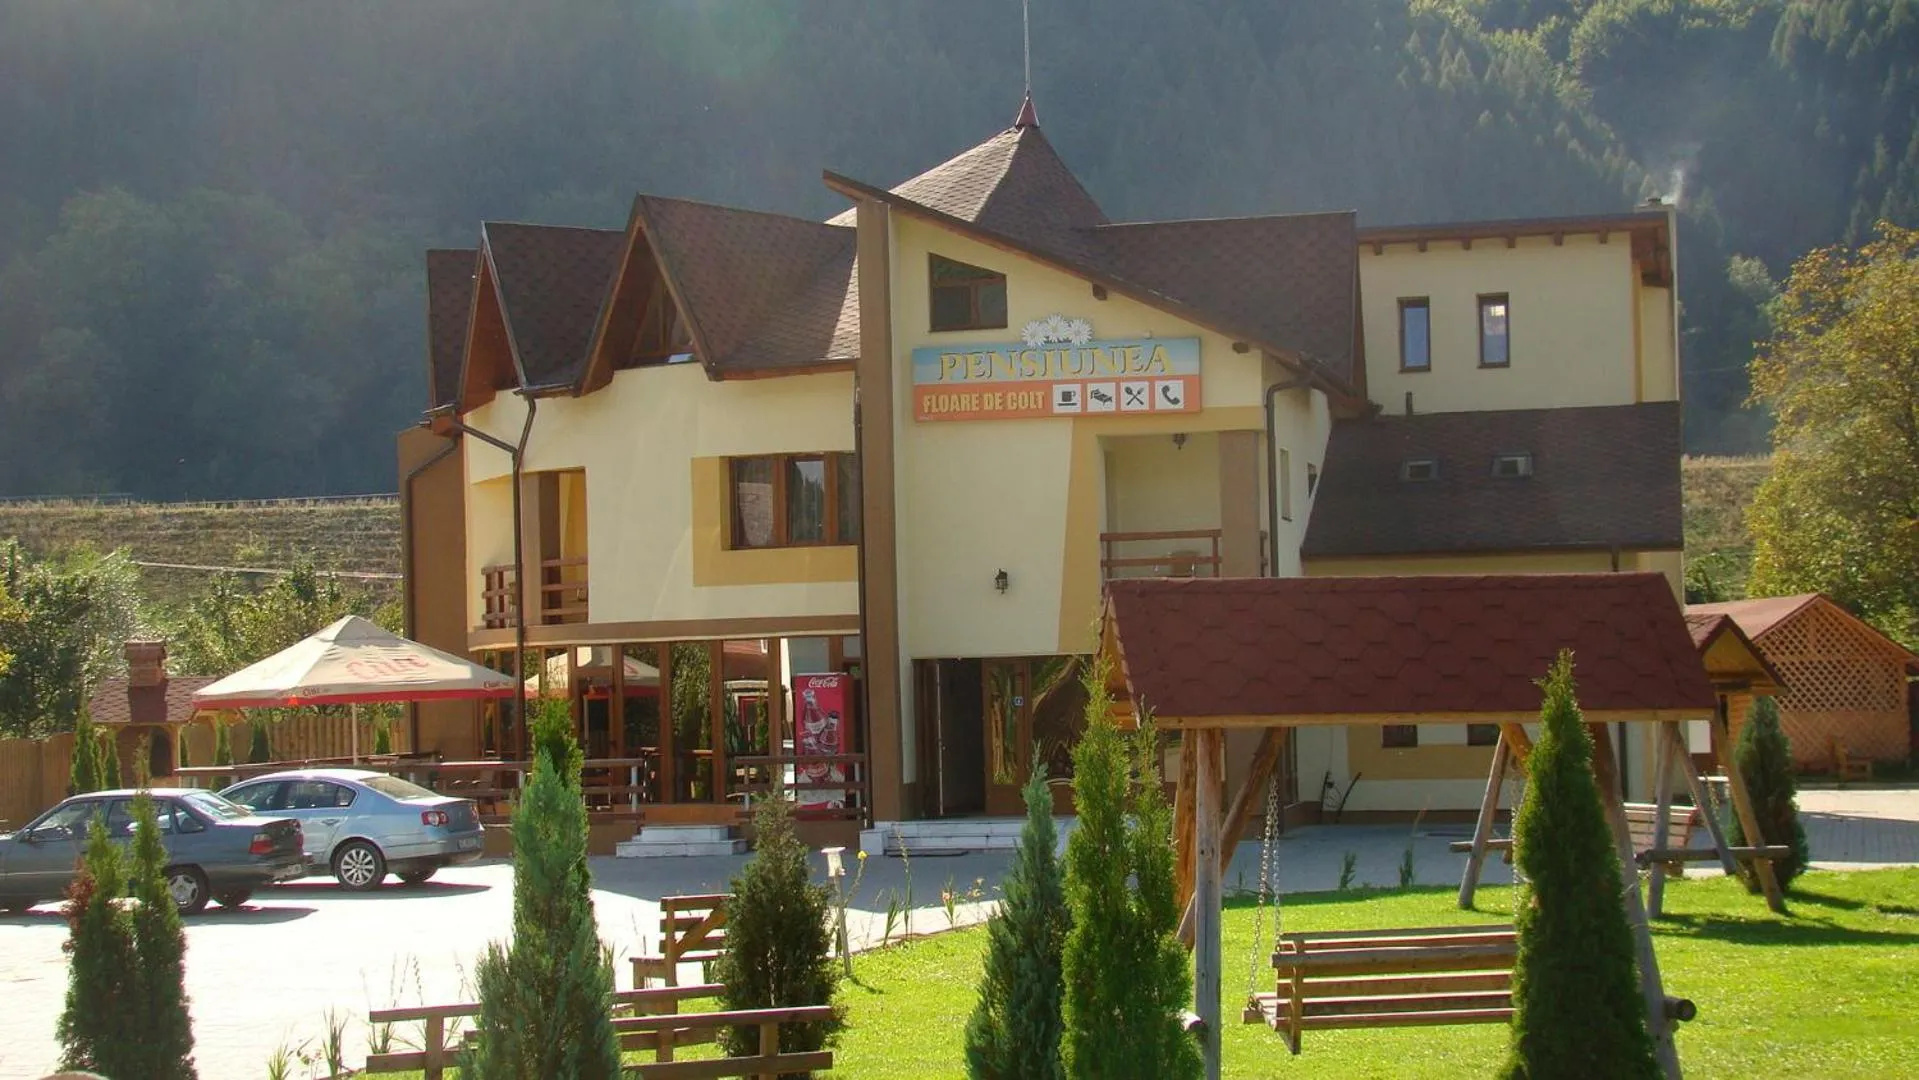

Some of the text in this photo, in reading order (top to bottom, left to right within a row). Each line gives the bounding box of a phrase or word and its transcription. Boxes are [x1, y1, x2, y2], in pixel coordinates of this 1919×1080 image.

[939, 344, 1176, 381] PENSIUNEA
[923, 391, 1045, 413] FLOARE DE COLT
